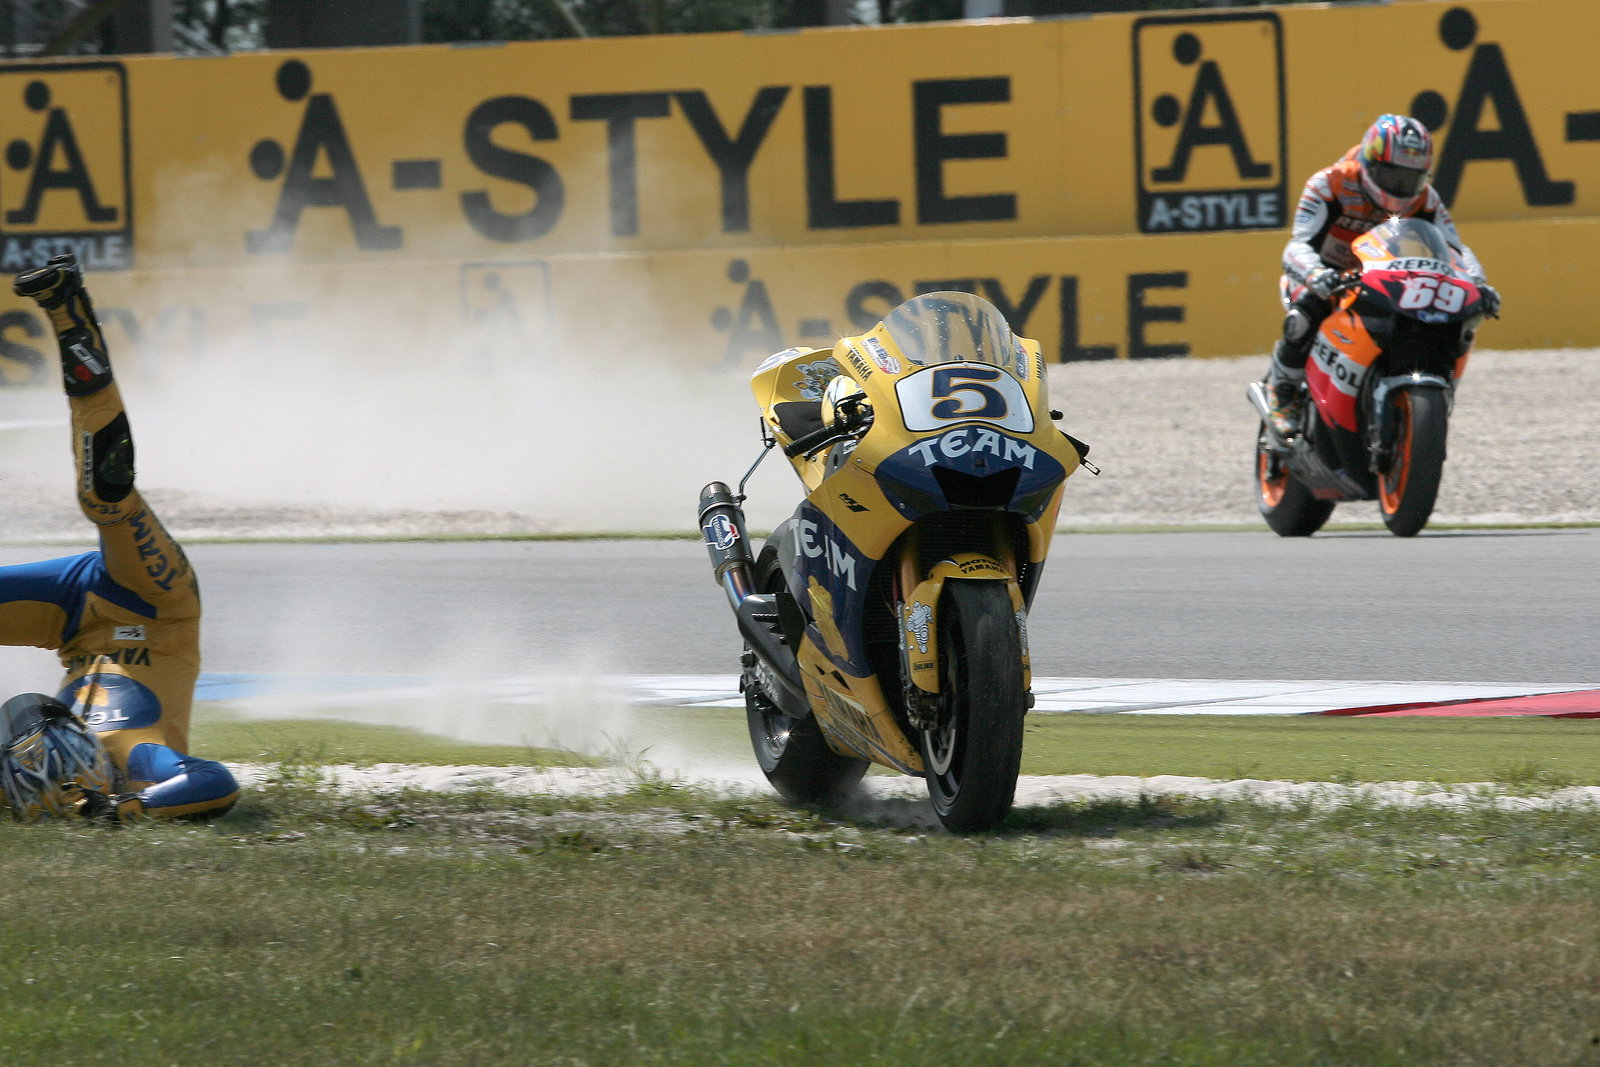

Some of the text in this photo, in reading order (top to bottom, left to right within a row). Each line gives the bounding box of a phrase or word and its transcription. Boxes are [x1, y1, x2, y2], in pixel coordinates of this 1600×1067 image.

[247, 75, 1018, 254] A-STYLE
[1148, 193, 1279, 230] A-STYLE
[1399, 277, 1466, 313] 69
[931, 367, 1008, 420] 5
[908, 430, 1037, 470] TEAM
[129, 510, 179, 591] TEAM
[960, 564, 1007, 575] YAMAHA
[82, 709, 130, 725] TE
